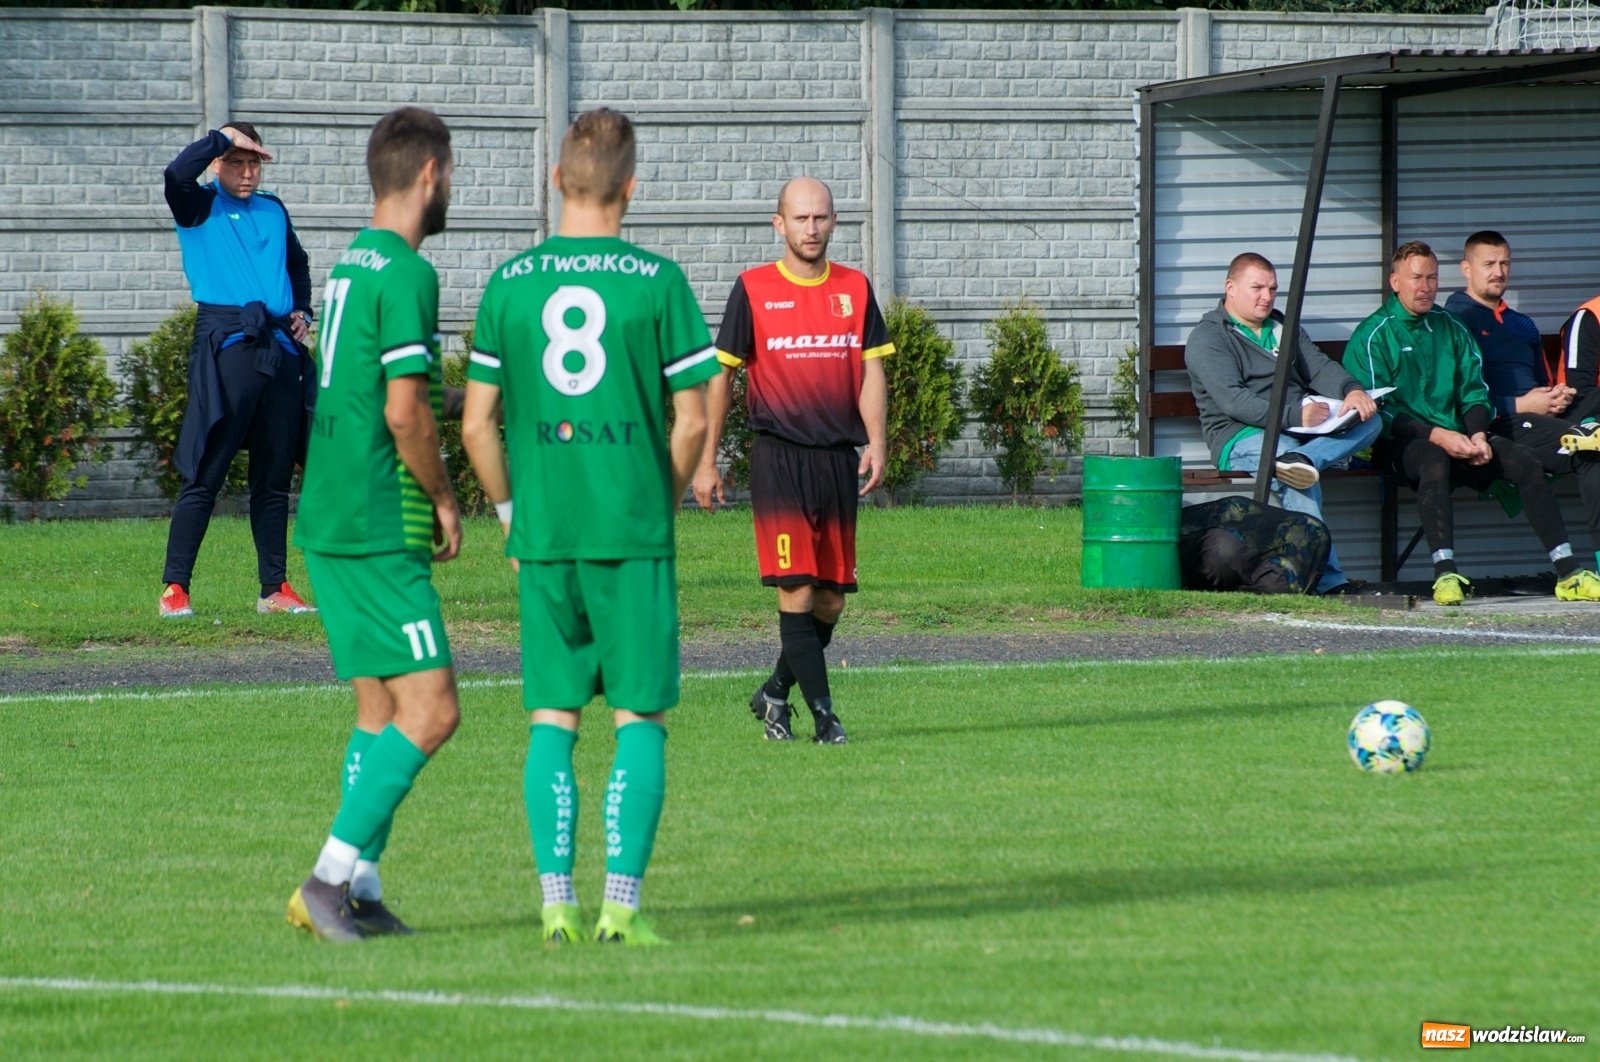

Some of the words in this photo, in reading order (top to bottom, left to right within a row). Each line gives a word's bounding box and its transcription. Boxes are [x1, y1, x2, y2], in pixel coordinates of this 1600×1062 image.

[502, 254, 535, 280] LKS
[539, 252, 660, 278] TWORKÓW
[541, 284, 607, 397] 8
[766, 331, 862, 351] mazur
[536, 418, 639, 446] ROSAT
[776, 533, 792, 570] 9
[401, 619, 438, 661] 11
